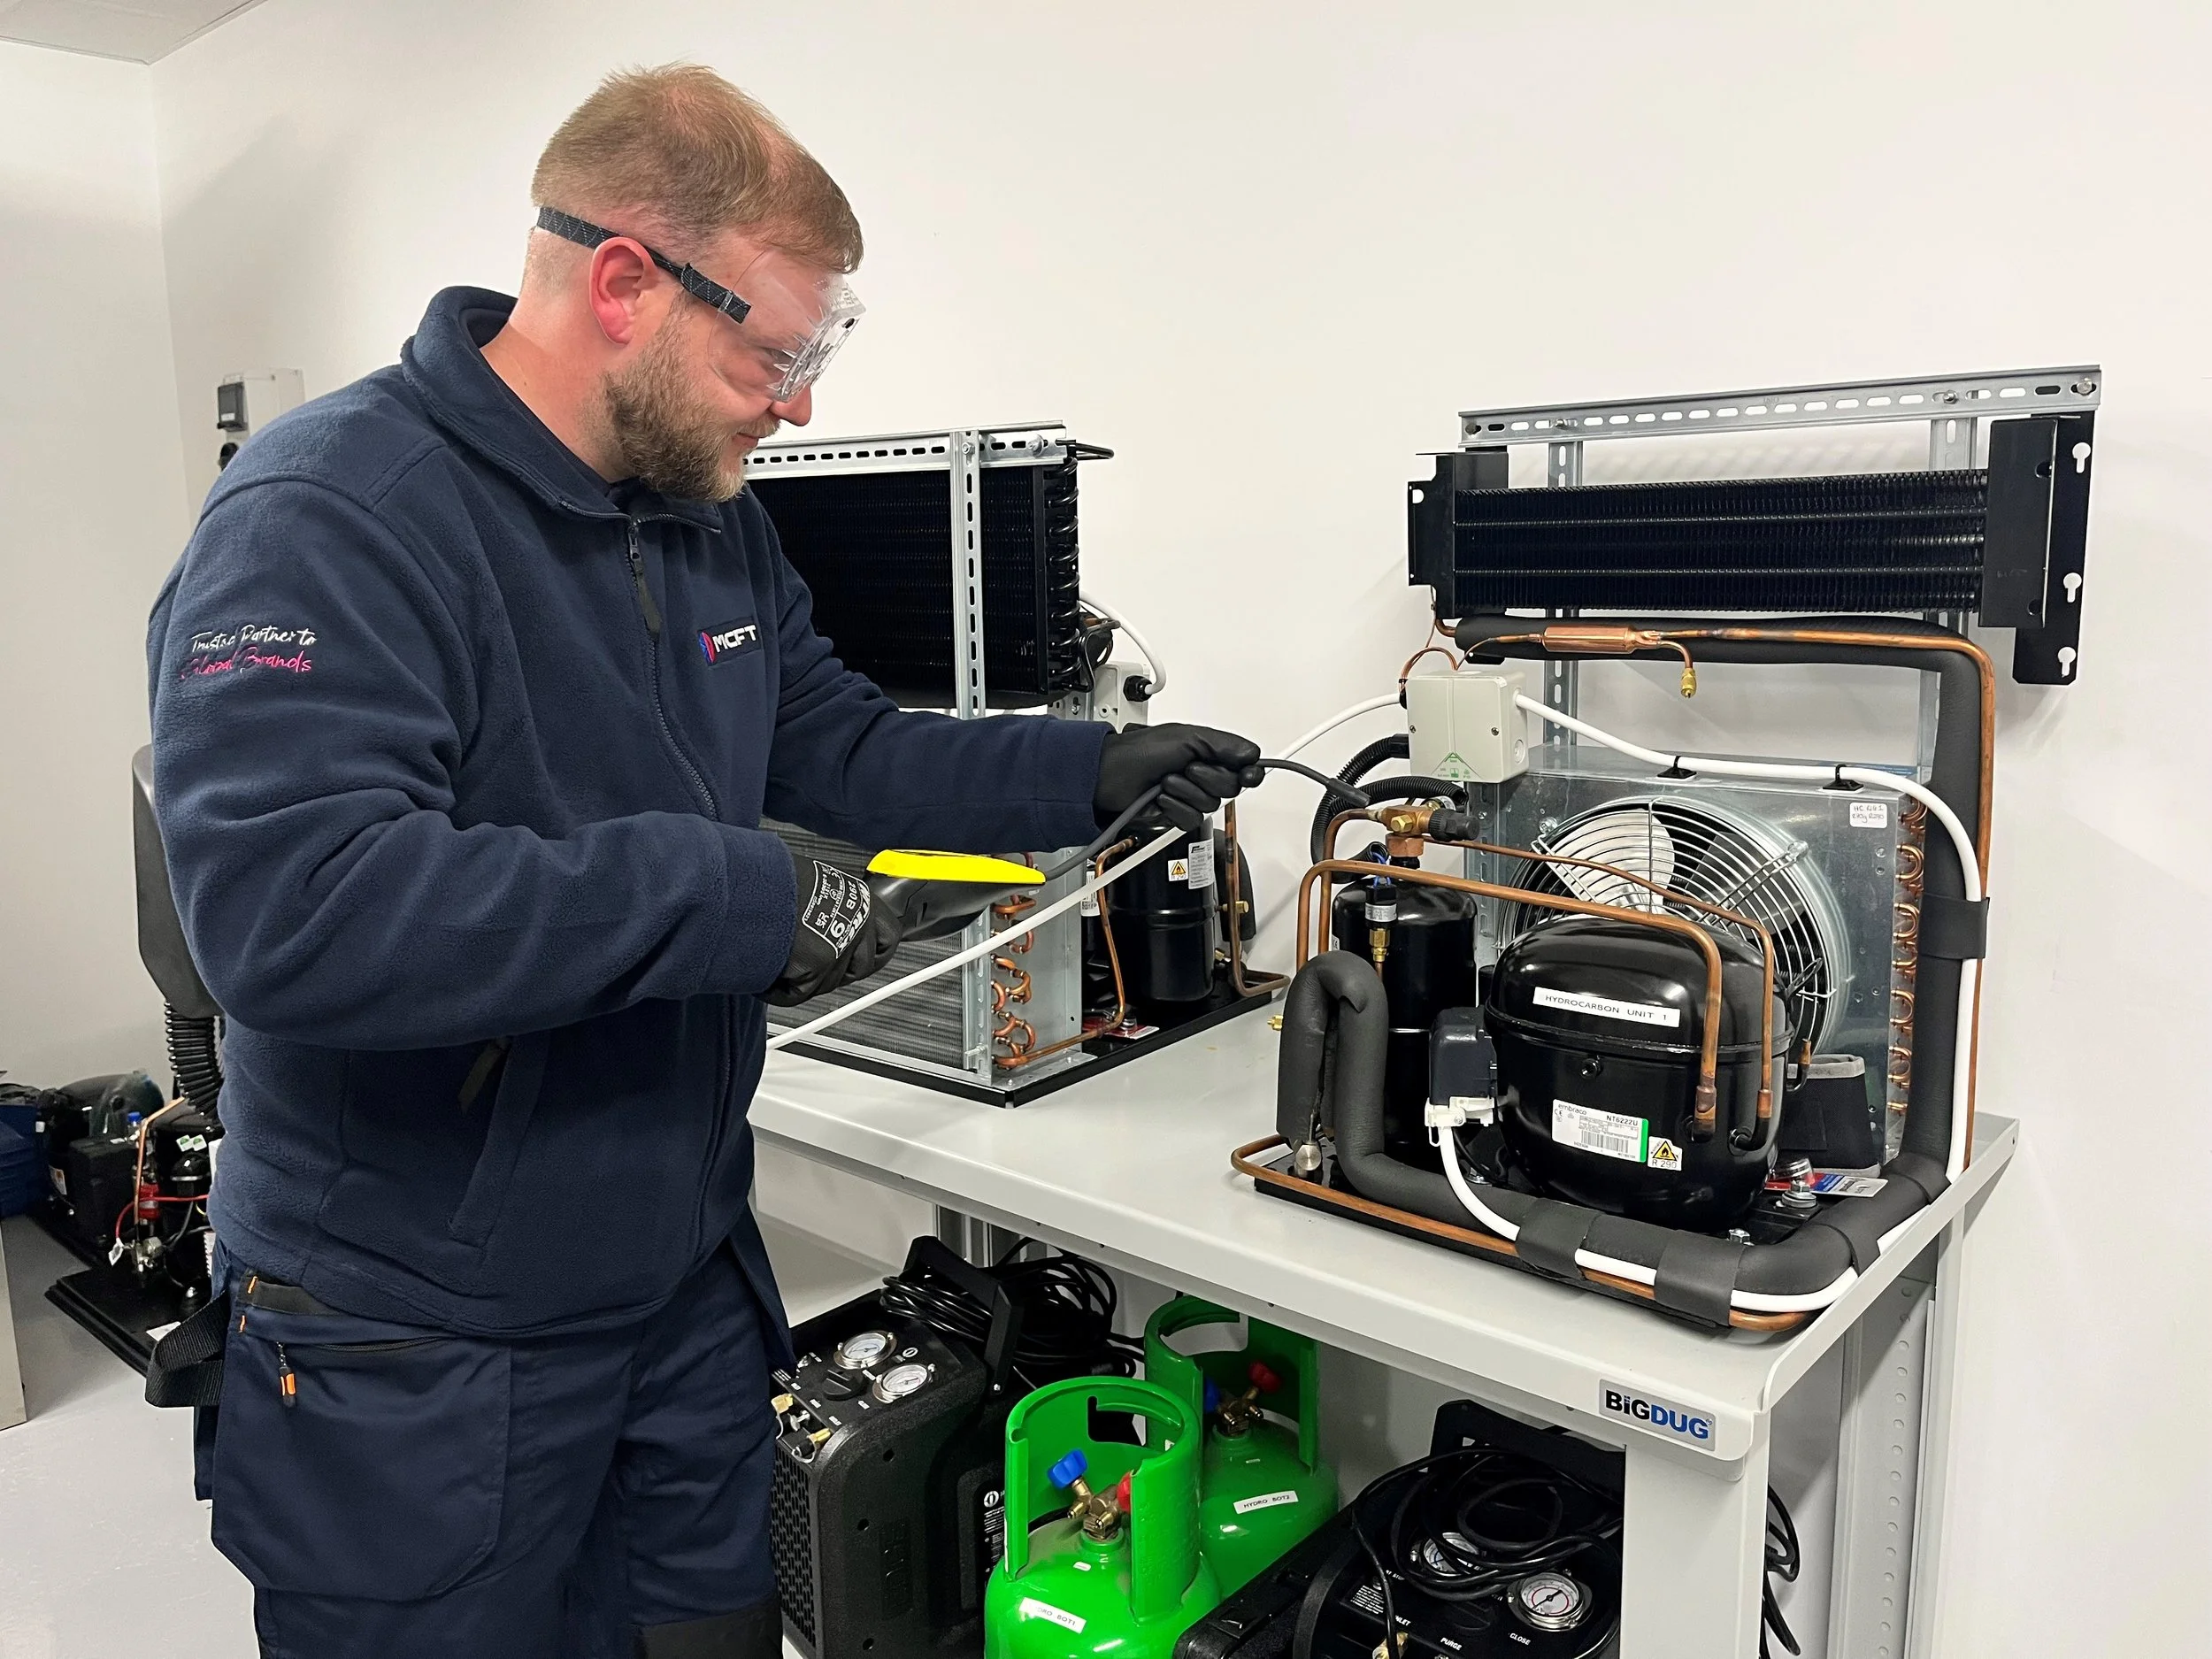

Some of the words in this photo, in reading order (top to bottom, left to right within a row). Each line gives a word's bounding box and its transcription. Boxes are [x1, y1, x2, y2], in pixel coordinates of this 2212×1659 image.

[191, 627, 237, 652] Trusted
[240, 624, 296, 645] Partner
[297, 628, 317, 645] to
[712, 625, 757, 653] MCFT
[242, 647, 311, 673] Brands
[846, 880, 857, 910] 290B
[1545, 995, 1620, 1014] HYDROCARBON
[1627, 1010, 1655, 1018] UNIT
[1558, 1103, 1587, 1116] embraco
[1606, 1115, 1638, 1126] NT6222U
[1244, 1499, 1268, 1509] HYDRO
[1056, 1615, 1076, 1625] BOT1
[1440, 1637, 1463, 1651] PURGE
[1509, 1632, 1531, 1646] CLOSE
